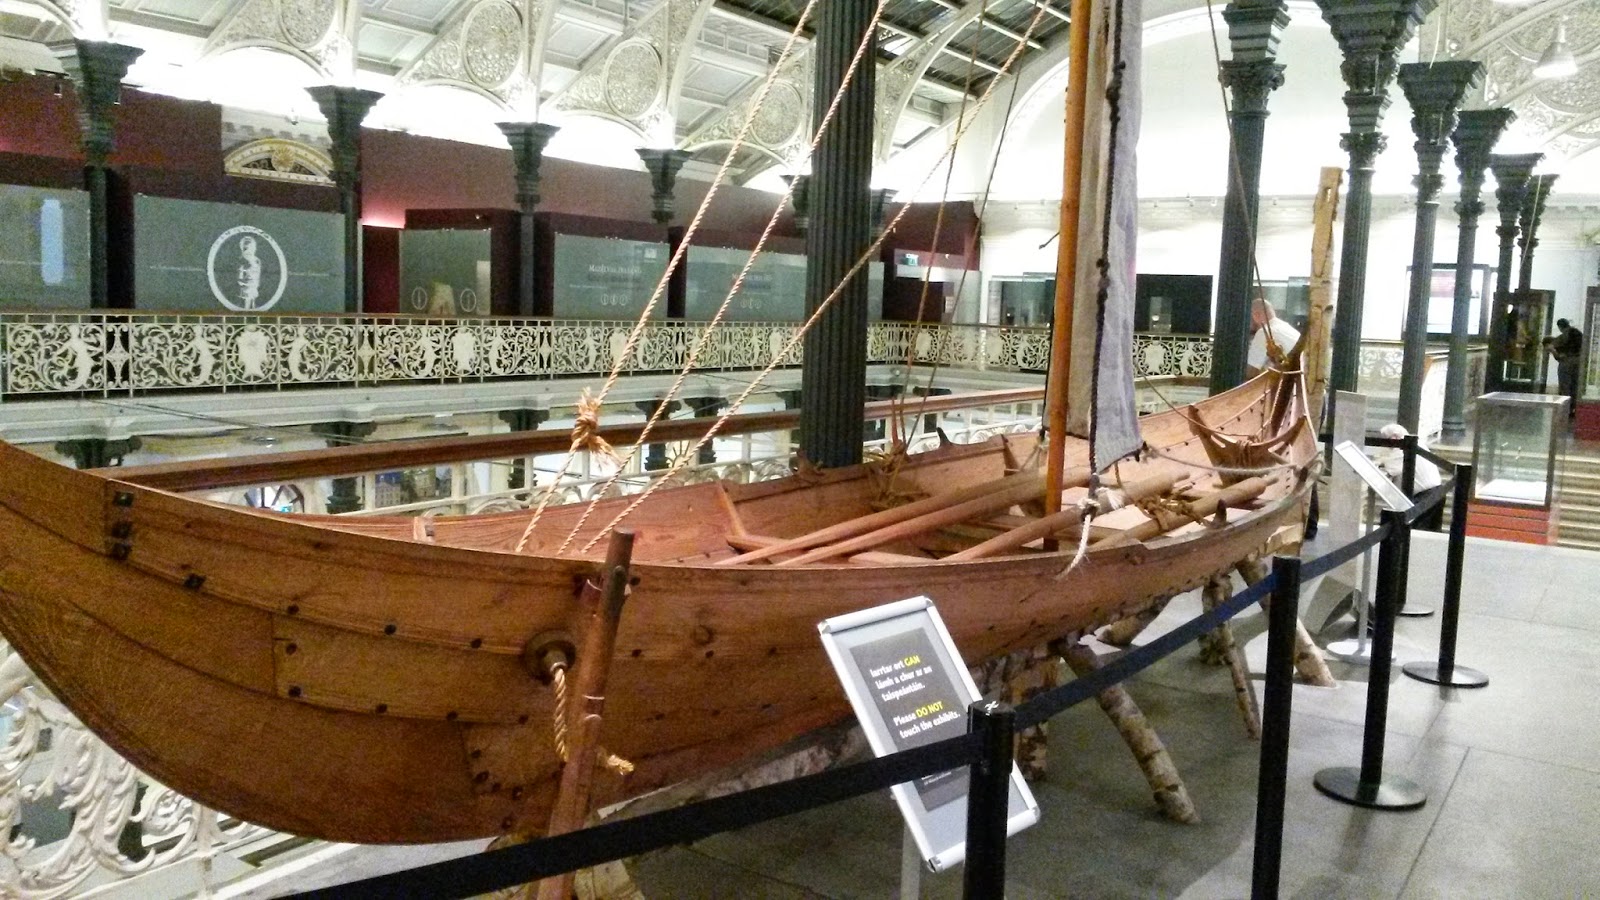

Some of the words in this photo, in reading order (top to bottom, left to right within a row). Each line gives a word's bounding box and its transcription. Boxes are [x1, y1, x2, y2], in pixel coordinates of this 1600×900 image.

[904, 655, 921, 667] GAN
[893, 711, 917, 726] Please
[915, 707, 929, 718] DO
[927, 701, 944, 713] NOT
[899, 724, 921, 739] touch
[920, 720, 933, 731] the
[933, 711, 961, 726] exhibits.
